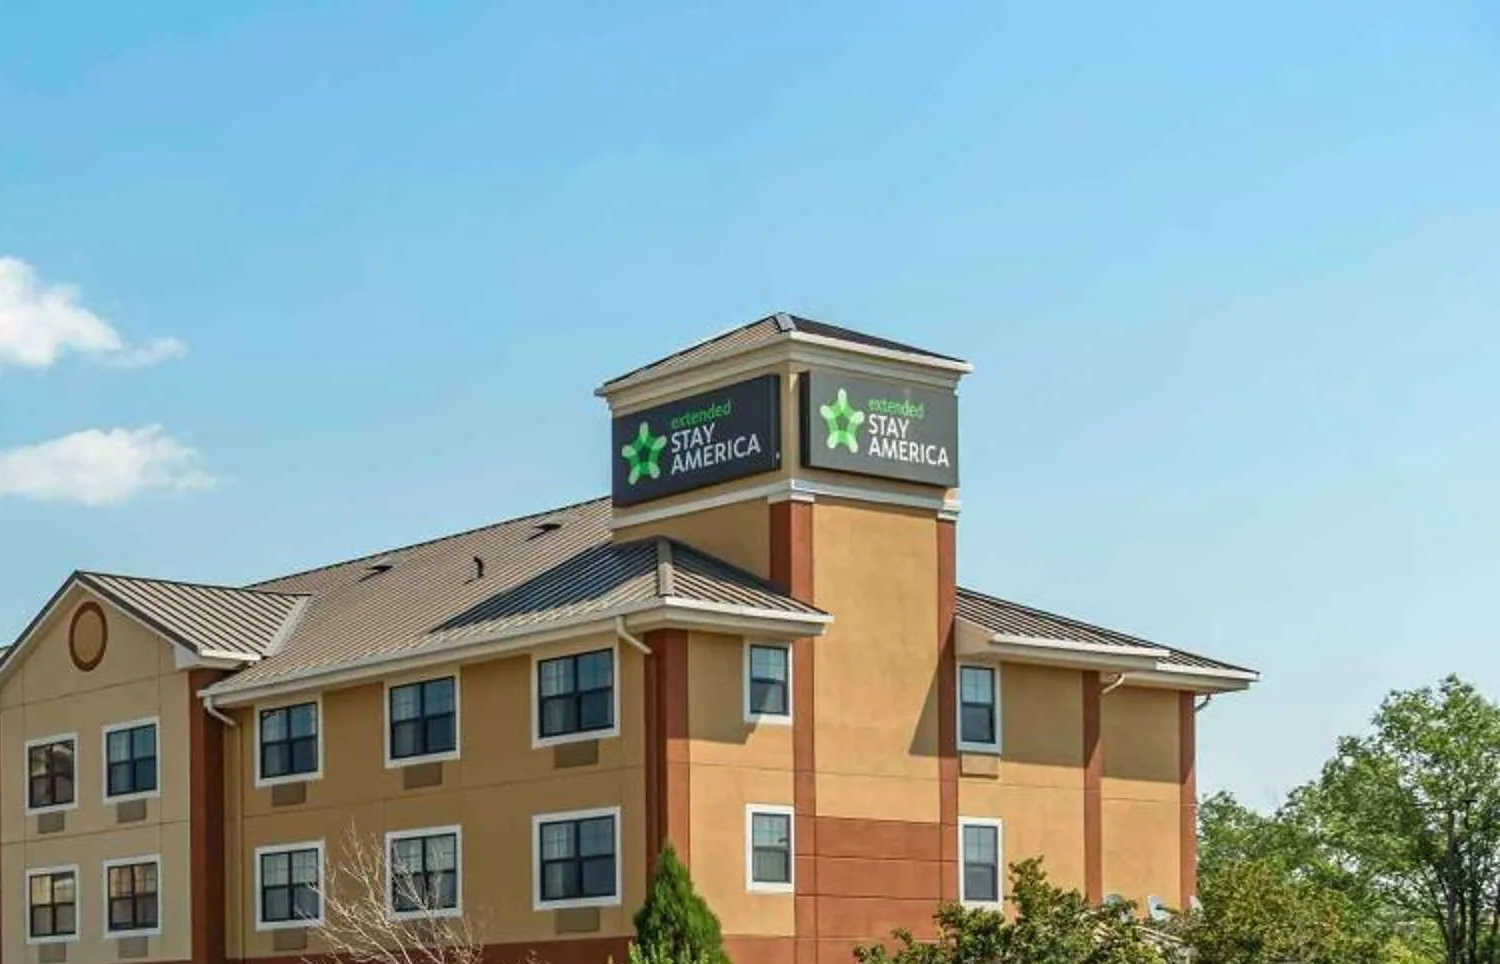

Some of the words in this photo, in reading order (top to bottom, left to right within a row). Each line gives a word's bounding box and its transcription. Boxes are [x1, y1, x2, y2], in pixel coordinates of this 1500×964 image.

[671, 401, 731, 428] extended
[868, 399, 925, 419] extended
[671, 423, 716, 453] STAY
[869, 414, 910, 437] STAY
[671, 434, 761, 475] AMERICA
[869, 438, 949, 467] AMERICA
